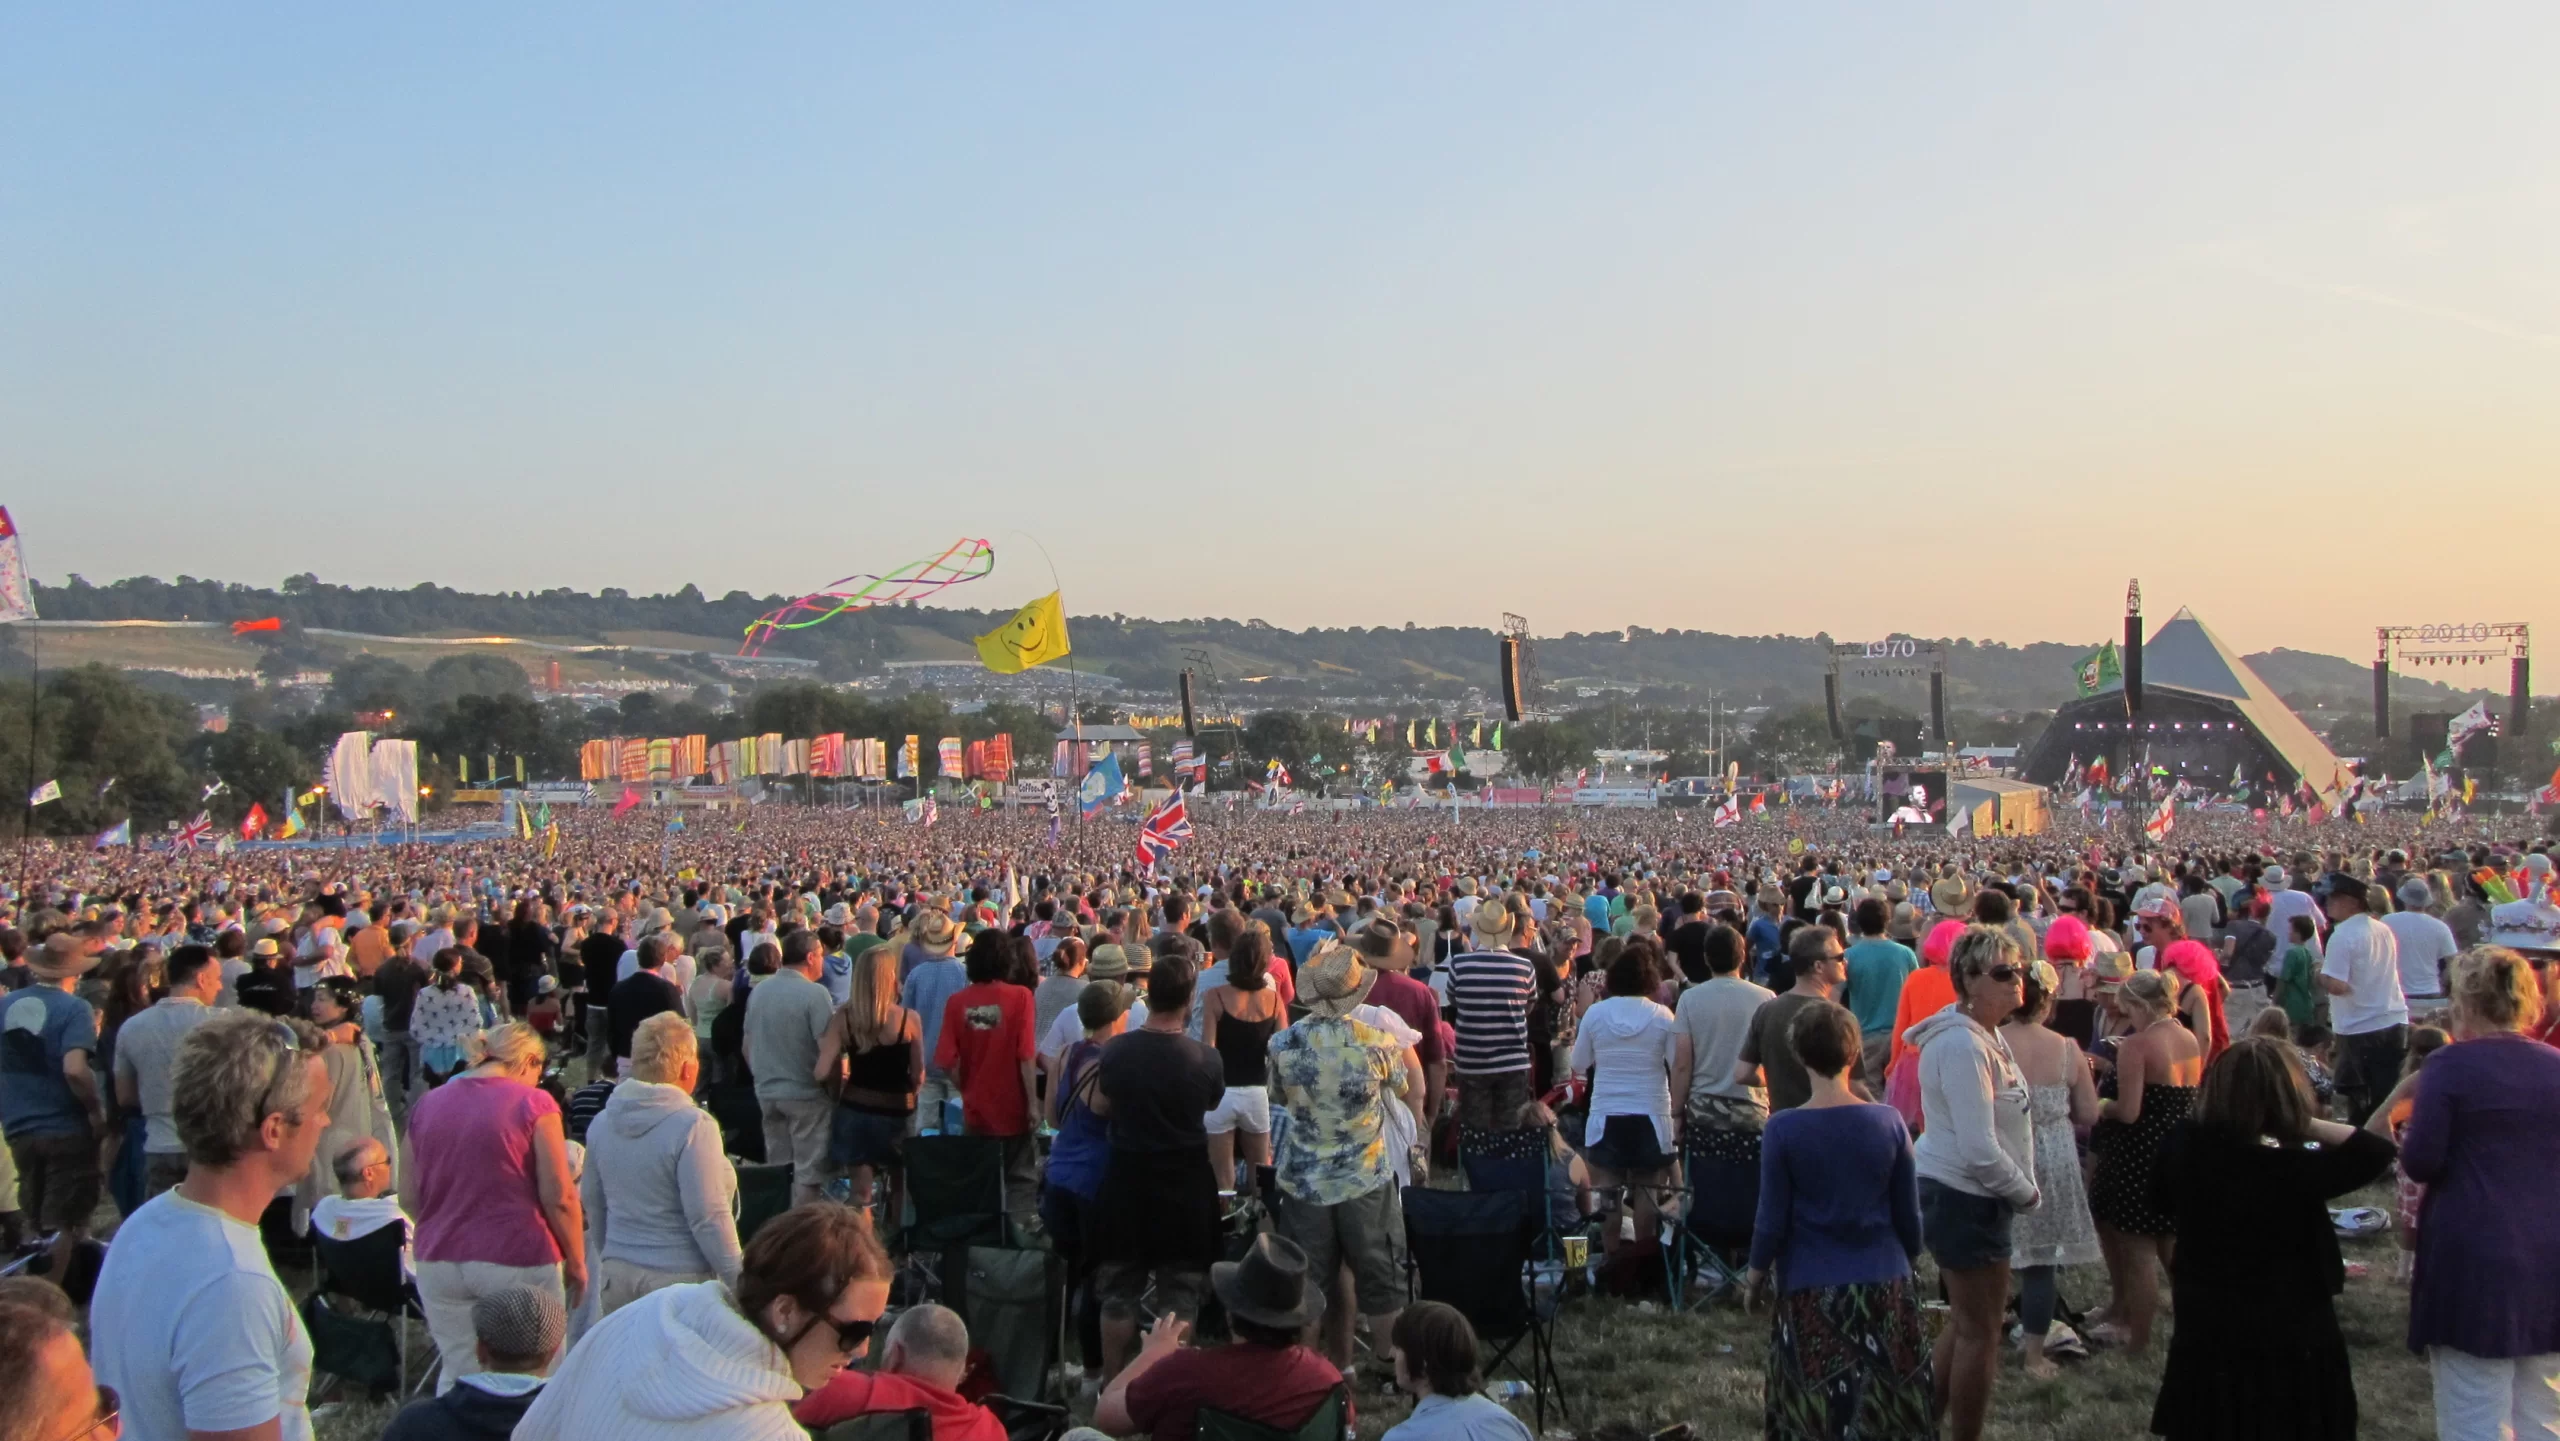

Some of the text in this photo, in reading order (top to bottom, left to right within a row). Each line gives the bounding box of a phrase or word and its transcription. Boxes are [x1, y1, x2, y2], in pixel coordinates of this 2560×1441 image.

[2420, 623, 2488, 643] 2010
[1862, 640, 1916, 658] 1970
[1019, 782, 1037, 793] Coffee
